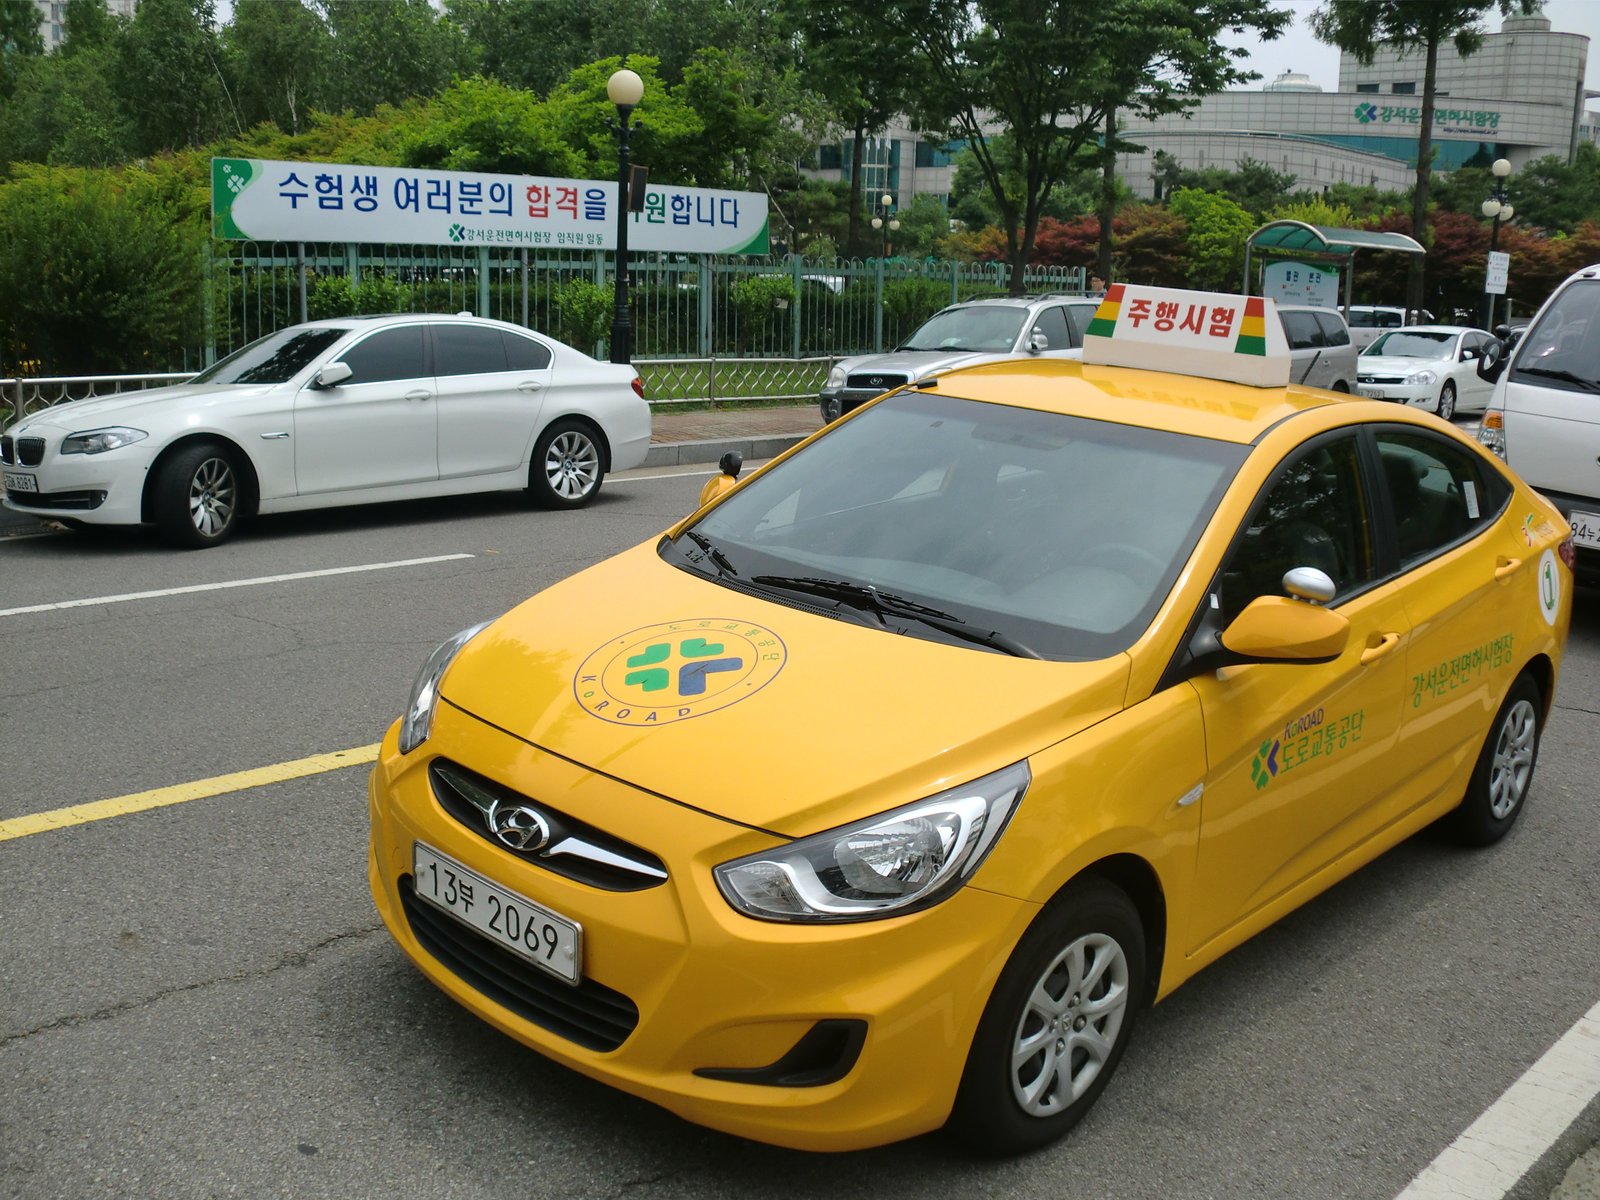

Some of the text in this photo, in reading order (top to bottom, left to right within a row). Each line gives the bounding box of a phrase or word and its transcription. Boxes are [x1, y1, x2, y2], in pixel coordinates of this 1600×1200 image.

[1380, 106, 1501, 128] 강서운면허시험장
[278, 172, 740, 228] 수험생 여러분의 합격을 원합니다
[466, 229, 604, 245] 강서운전면허시험장 임직원 일동
[1127, 299, 1236, 338] 주행시험
[1411, 633, 1514, 708] 강서운전면허시험장
[1280, 708, 1364, 774] 도로교통공단
[429, 862, 558, 960] 13부 2069
